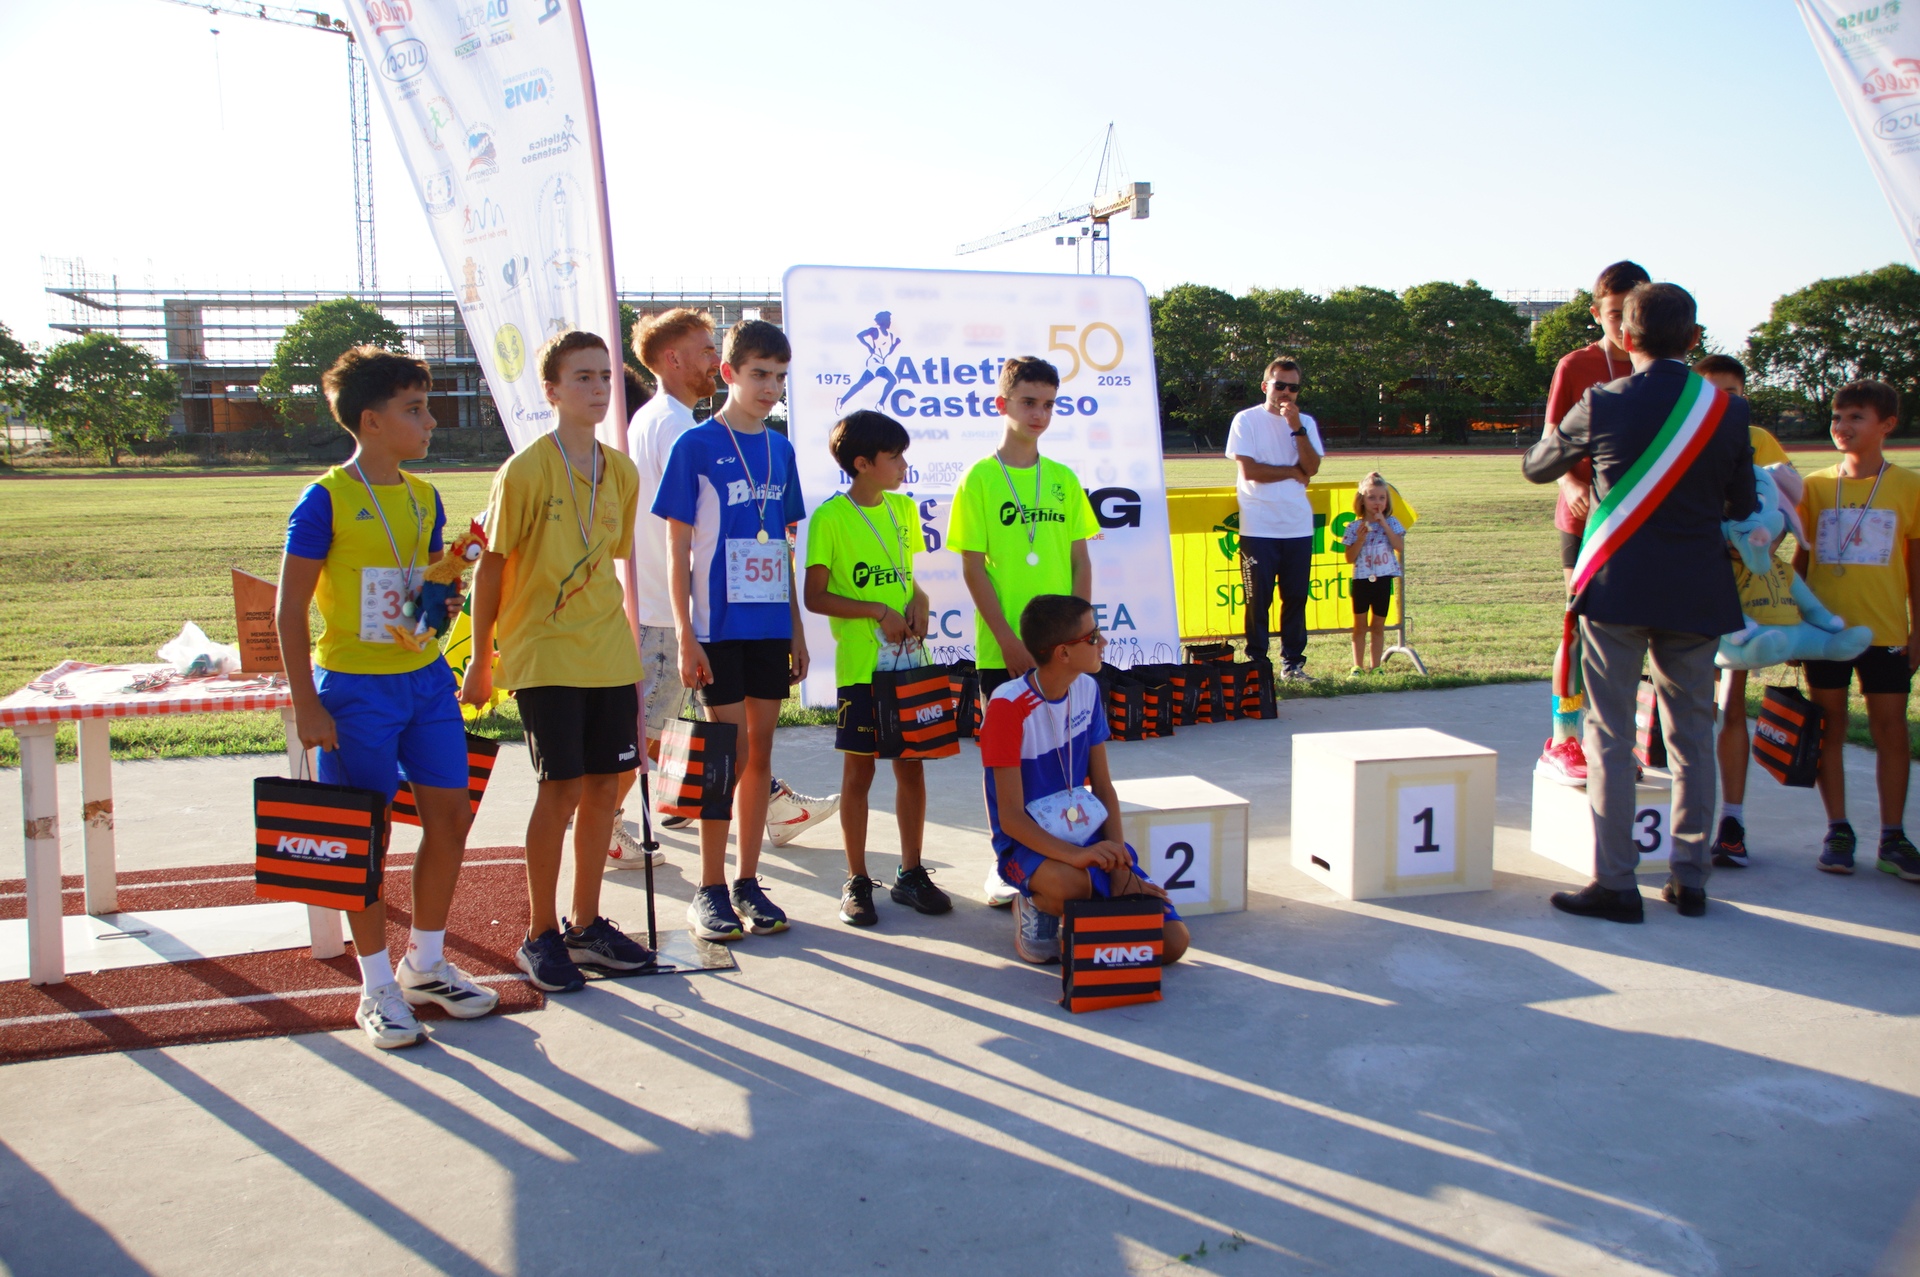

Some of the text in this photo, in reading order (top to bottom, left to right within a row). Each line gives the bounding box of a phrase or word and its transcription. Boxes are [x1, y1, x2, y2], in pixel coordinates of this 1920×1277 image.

[1049, 322, 1124, 383] 50
[815, 374, 851, 386] 1975
[1097, 375, 1132, 387] 2025
[891, 389, 1098, 418] Casteso
[1021, 510, 1065, 525] Ethics
[745, 558, 783, 584] 551
[1364, 552, 1389, 569] 540
[916, 704, 943, 724] KING
[1757, 721, 1788, 746] KING
[618, 750, 635, 762] PUMA
[663, 759, 688, 778] KING
[1413, 807, 1440, 853] 1
[1633, 808, 1661, 853] 3
[276, 835, 348, 860] KING
[1163, 841, 1195, 890] 2
[1093, 945, 1154, 964] KING
